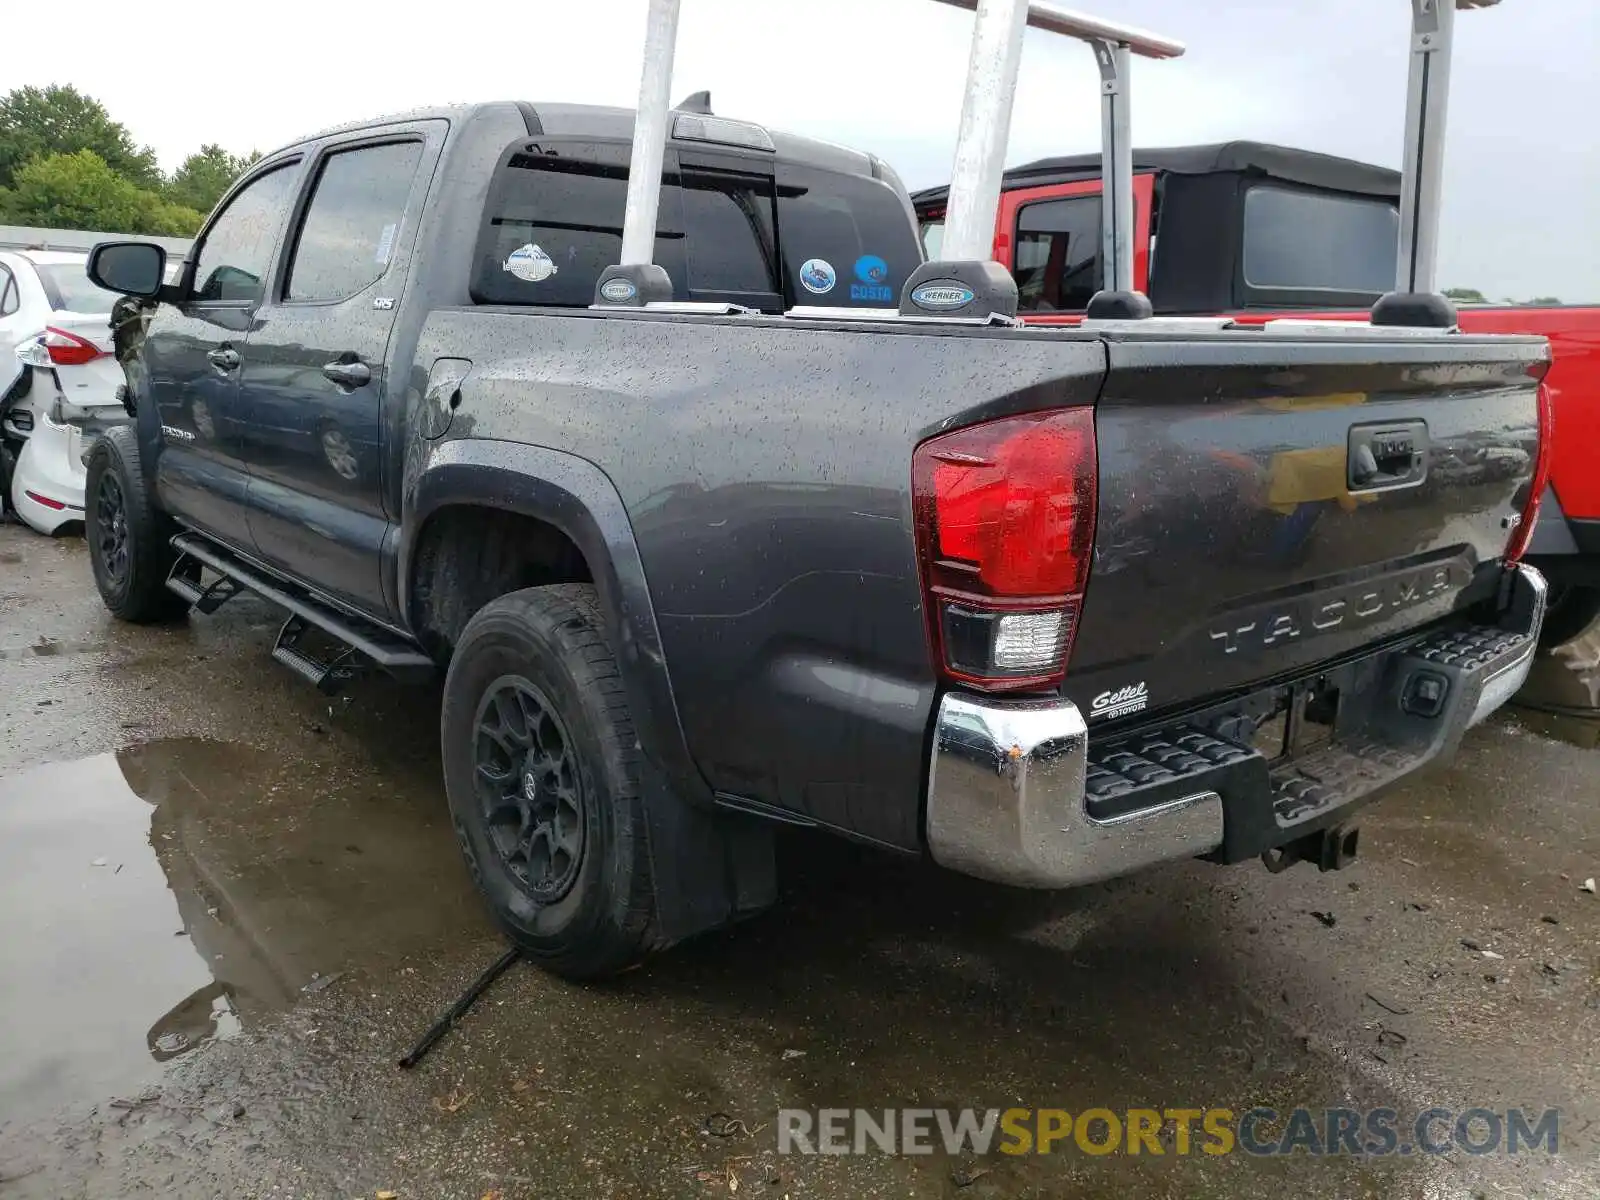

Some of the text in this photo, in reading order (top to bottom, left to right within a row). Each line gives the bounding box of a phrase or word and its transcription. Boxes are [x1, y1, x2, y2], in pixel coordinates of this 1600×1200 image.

[850, 284, 892, 300] COSTA
[925, 290, 962, 300] WERNER
[1209, 570, 1449, 653] TACOMA
[1091, 681, 1149, 709] Gettel
[1118, 701, 1147, 716] TOYOTA
